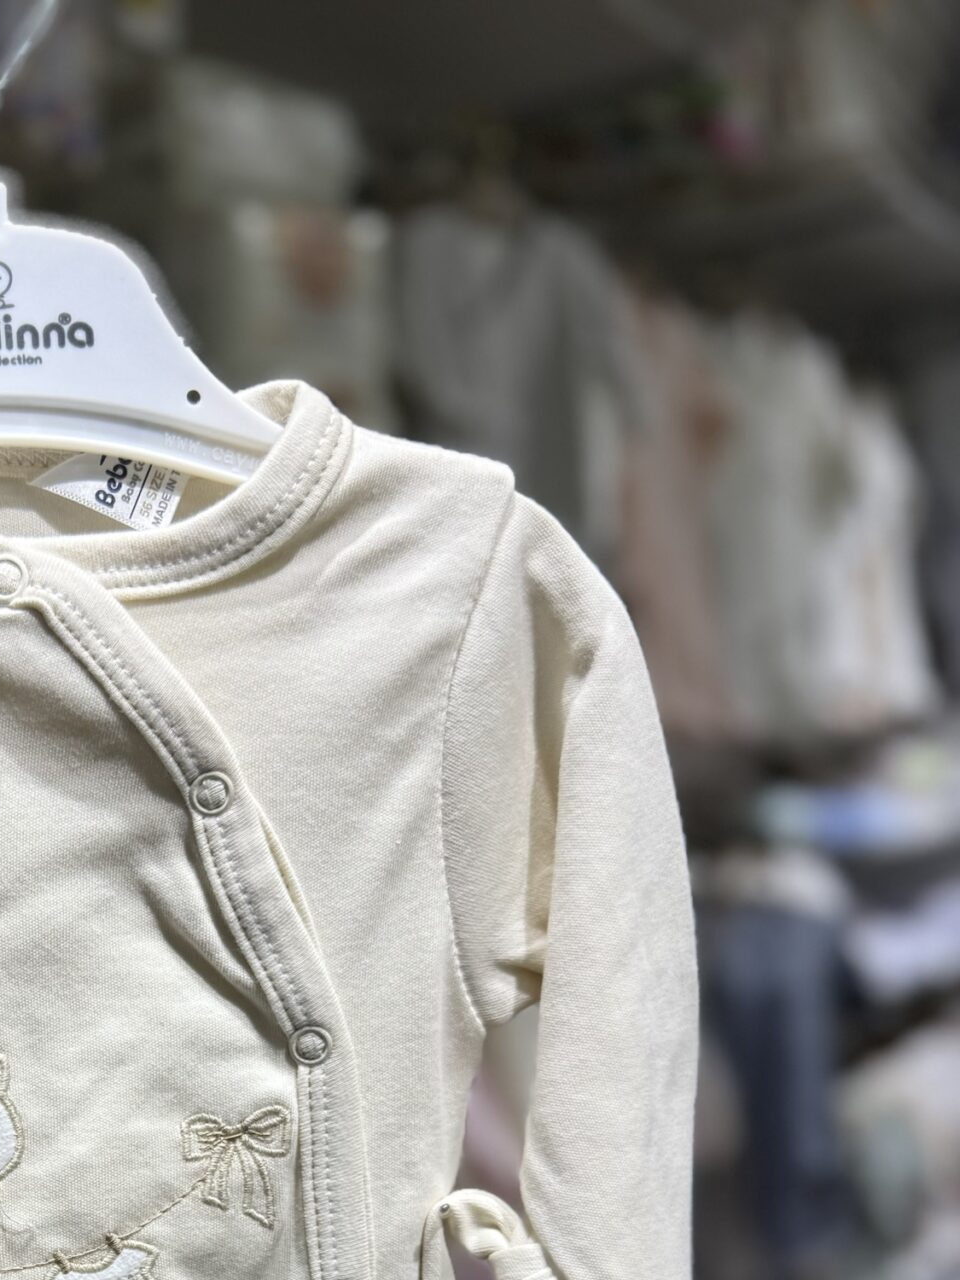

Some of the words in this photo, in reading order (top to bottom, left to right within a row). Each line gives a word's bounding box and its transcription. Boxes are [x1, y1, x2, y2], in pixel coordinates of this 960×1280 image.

[121, 473, 142, 504] Baby
[146, 470, 166, 501] SIZE
[151, 492, 173, 528] MADE
[165, 477, 178, 493] IN
